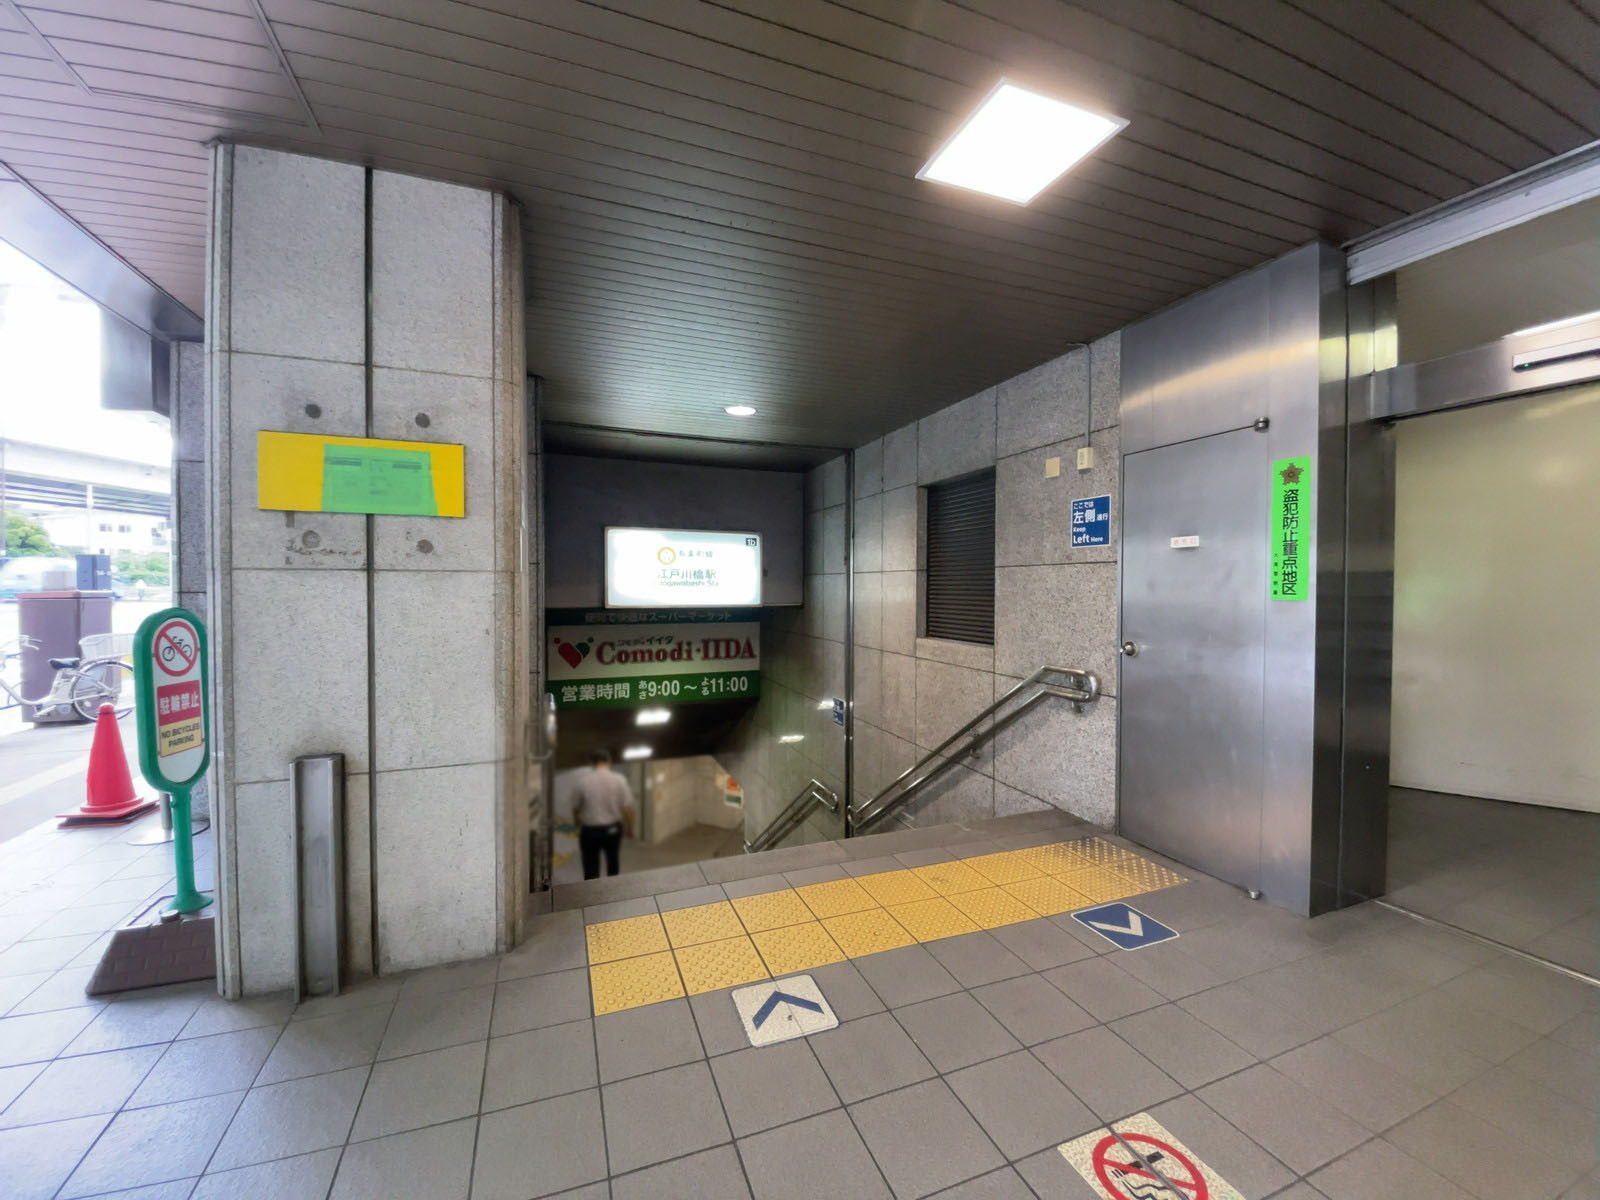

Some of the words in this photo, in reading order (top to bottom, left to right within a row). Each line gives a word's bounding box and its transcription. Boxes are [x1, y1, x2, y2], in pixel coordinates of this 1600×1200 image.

[1073, 501, 1094, 510] ここでは
[1073, 533, 1090, 544] Left
[1281, 488, 1299, 596] 盗犯防止重点地区
[657, 568, 717, 580] 江戸川橋駅
[561, 682, 631, 702] 営業時間
[160, 691, 200, 715] 駐輪禁止
[162, 730, 171, 738] NO
[172, 722, 200, 737] BICYCLES
[168, 734, 194, 748] PARKING
